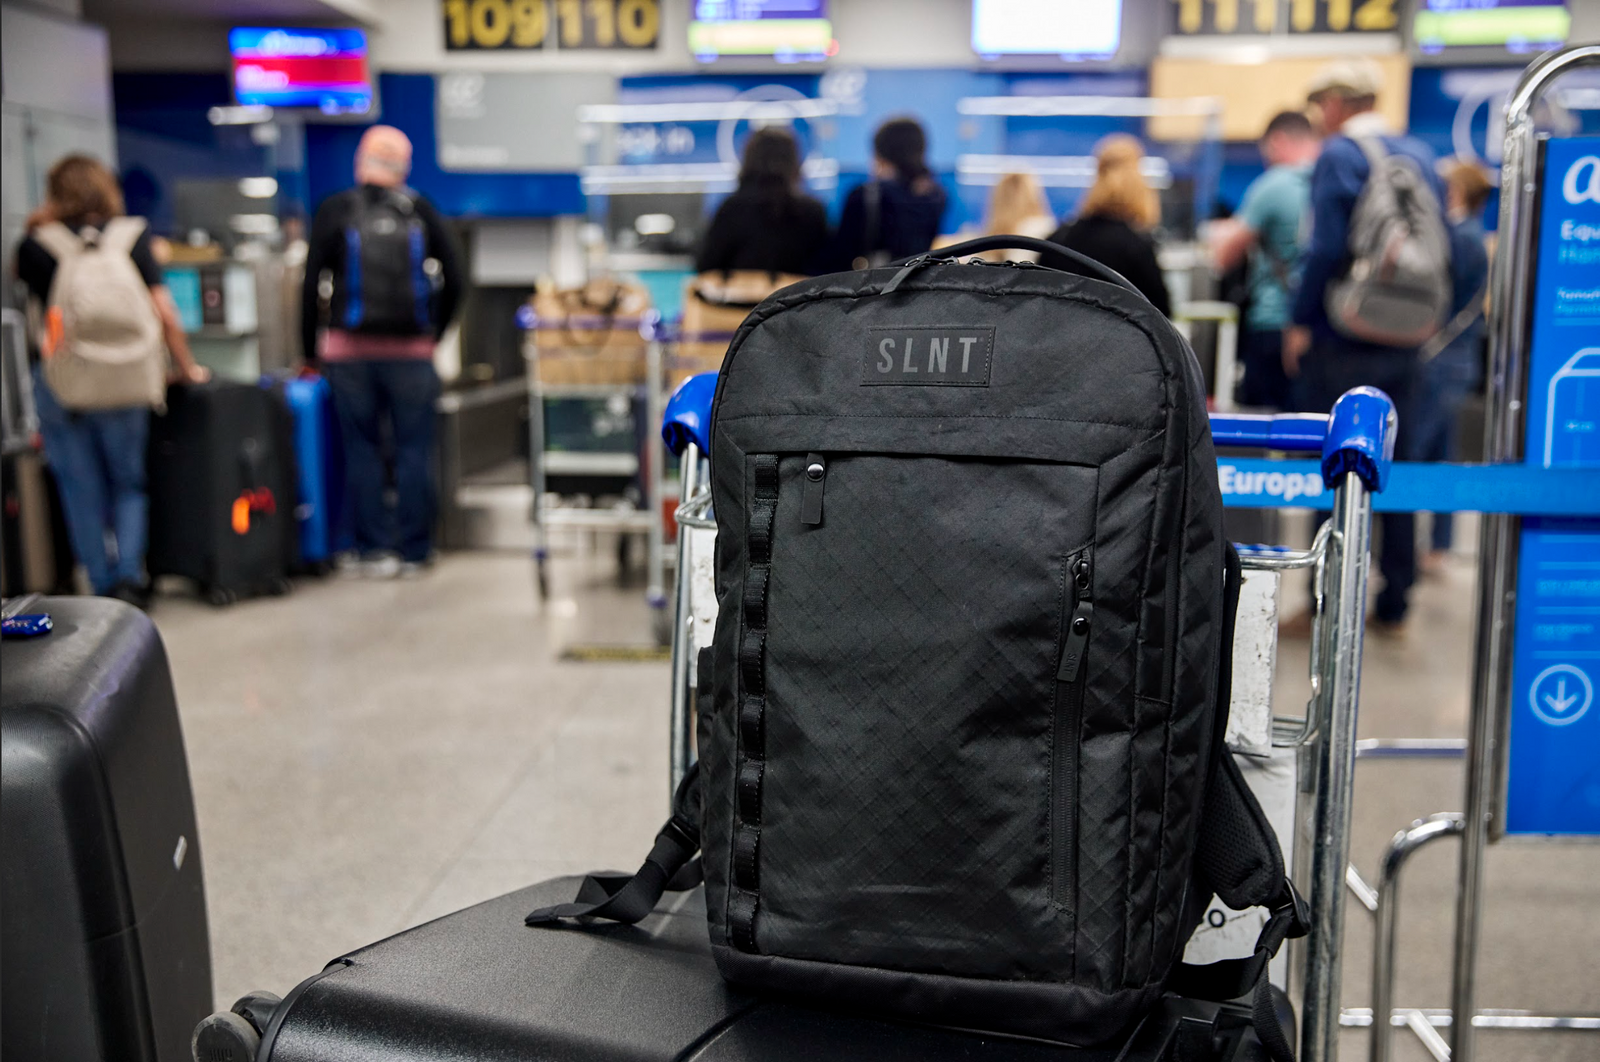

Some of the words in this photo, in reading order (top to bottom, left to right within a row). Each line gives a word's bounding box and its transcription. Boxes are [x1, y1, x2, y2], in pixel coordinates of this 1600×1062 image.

[445, 0, 546, 48] 109
[557, 0, 660, 47] 110
[876, 337, 978, 374] SLNT
[1218, 465, 1324, 502] Europa
